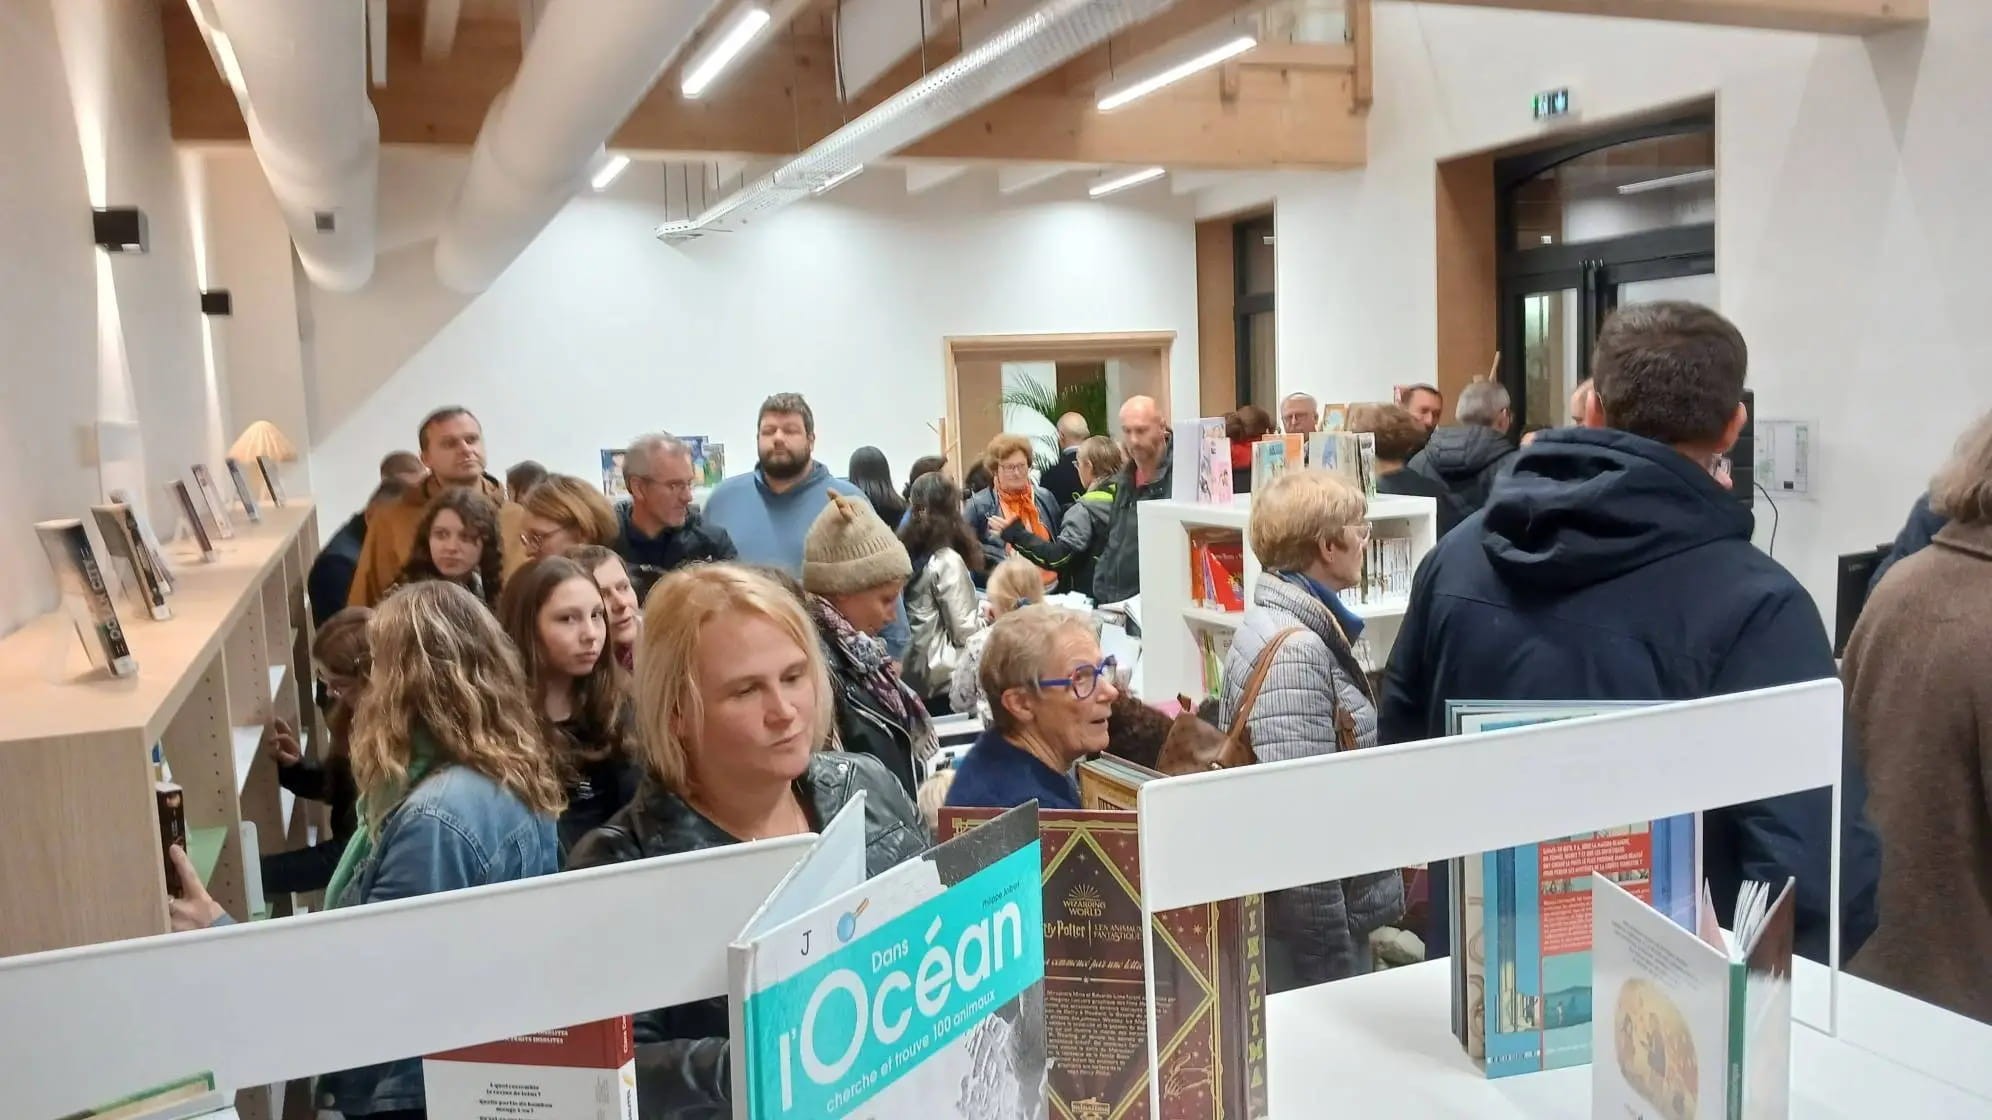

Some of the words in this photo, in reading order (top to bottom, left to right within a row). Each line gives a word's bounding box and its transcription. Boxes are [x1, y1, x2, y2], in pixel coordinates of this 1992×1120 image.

[1062, 900, 1106, 910] WIZARDING
[1068, 908, 1102, 916] WORLD
[800, 930, 812, 956] J
[1057, 920, 1086, 940] Potter
[872, 939, 909, 974] Dans
[780, 901, 1022, 1112] l'Océan
[826, 1070, 878, 1112] cherche
[880, 1058, 892, 1076] et
[895, 1034, 930, 1068] trouve
[933, 1016, 952, 1041] 100
[954, 989, 996, 1026] animaux
